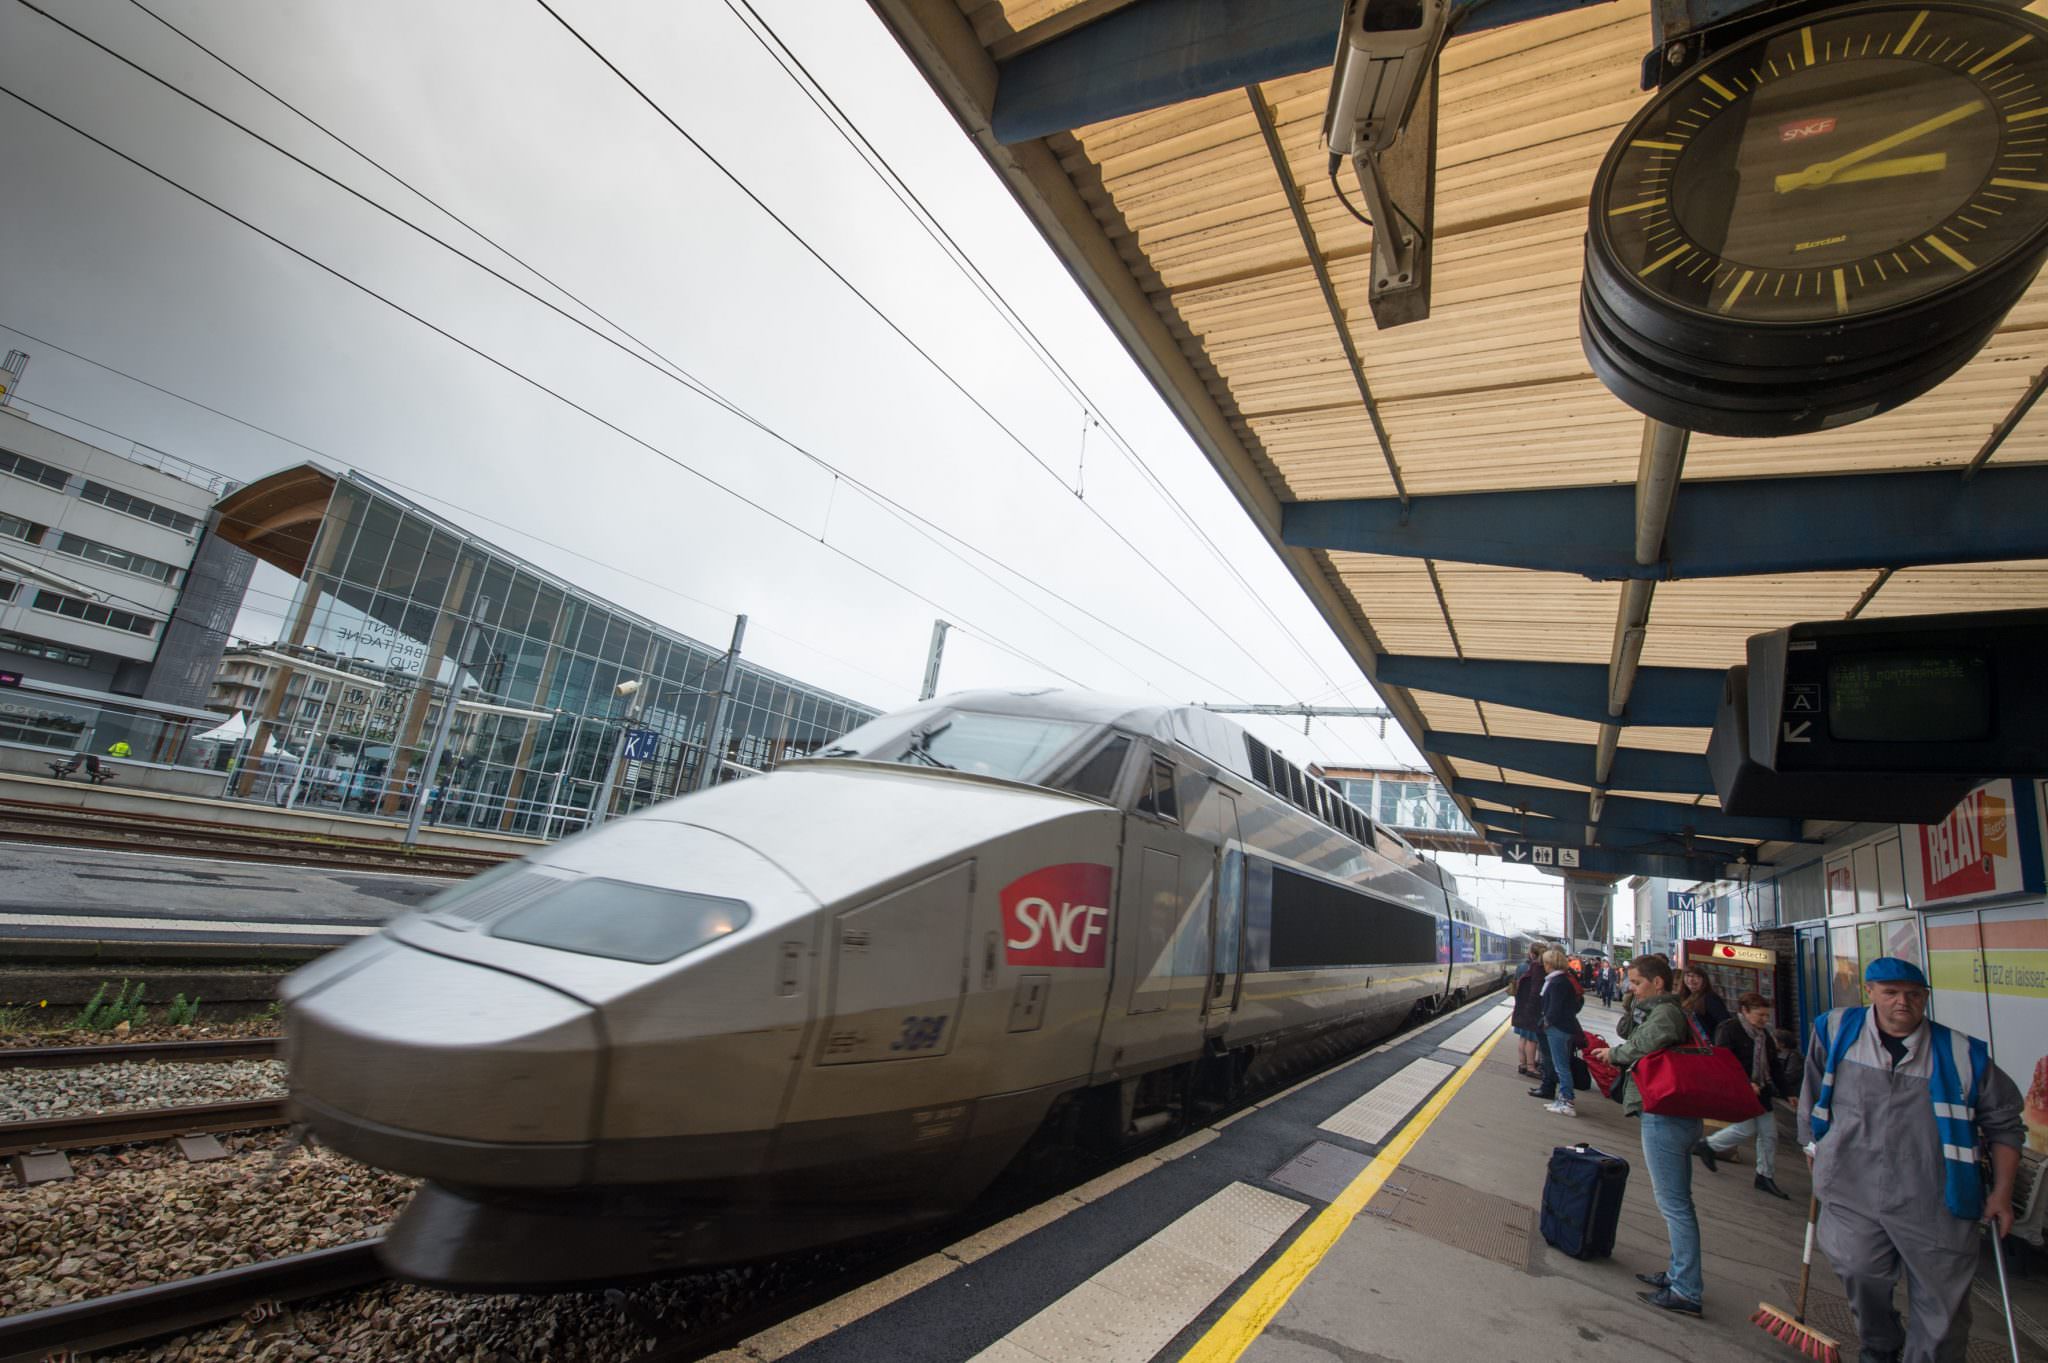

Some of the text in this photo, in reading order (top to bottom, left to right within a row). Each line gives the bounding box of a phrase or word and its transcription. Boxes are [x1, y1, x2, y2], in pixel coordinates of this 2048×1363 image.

[1783, 119, 1833, 142] SNCF
[1793, 694, 1811, 710] A
[624, 736, 641, 758] K
[1927, 791, 1981, 885] RELAY
[1679, 897, 1695, 911] M
[1008, 897, 1108, 954] SNCF
[1737, 949, 1768, 961] selecta
